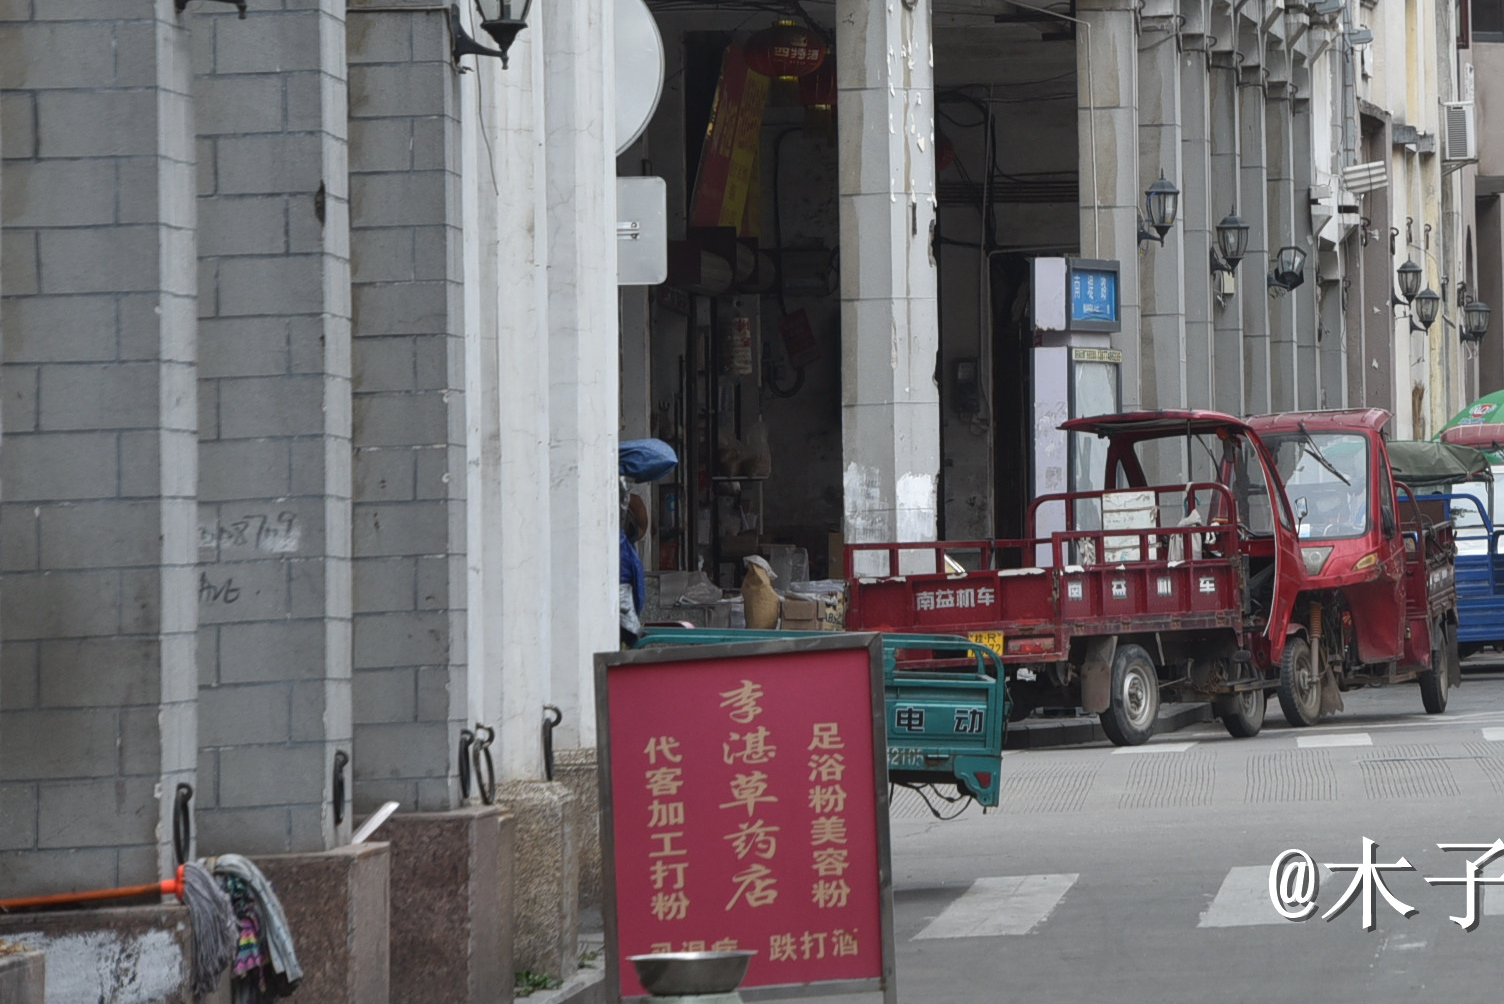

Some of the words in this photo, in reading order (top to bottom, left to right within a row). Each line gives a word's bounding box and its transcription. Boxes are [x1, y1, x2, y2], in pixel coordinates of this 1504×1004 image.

[916, 588, 996, 611] 南益机车
[719, 679, 780, 912] 李湛草药店
[895, 707, 985, 734] 电动
[643, 736, 690, 921] 代客加工打粉
[807, 722, 851, 909] 足浴粉美容粉
